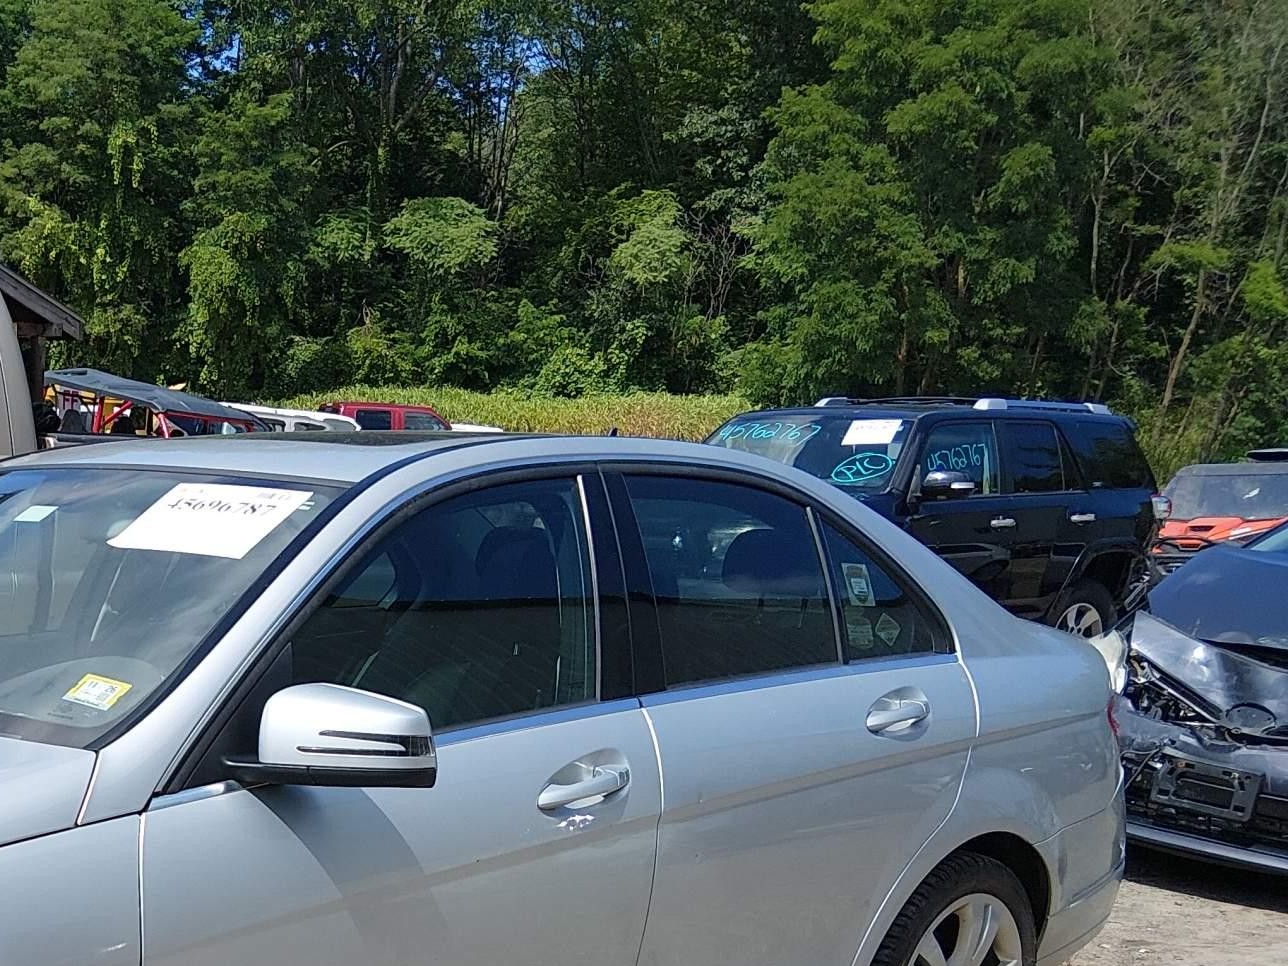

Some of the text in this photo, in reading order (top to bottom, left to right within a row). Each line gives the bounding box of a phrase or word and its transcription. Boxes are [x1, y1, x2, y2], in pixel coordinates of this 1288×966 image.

[720, 423, 821, 447] 45762767
[837, 456, 886, 481] PLC
[168, 497, 278, 515] 45696787
